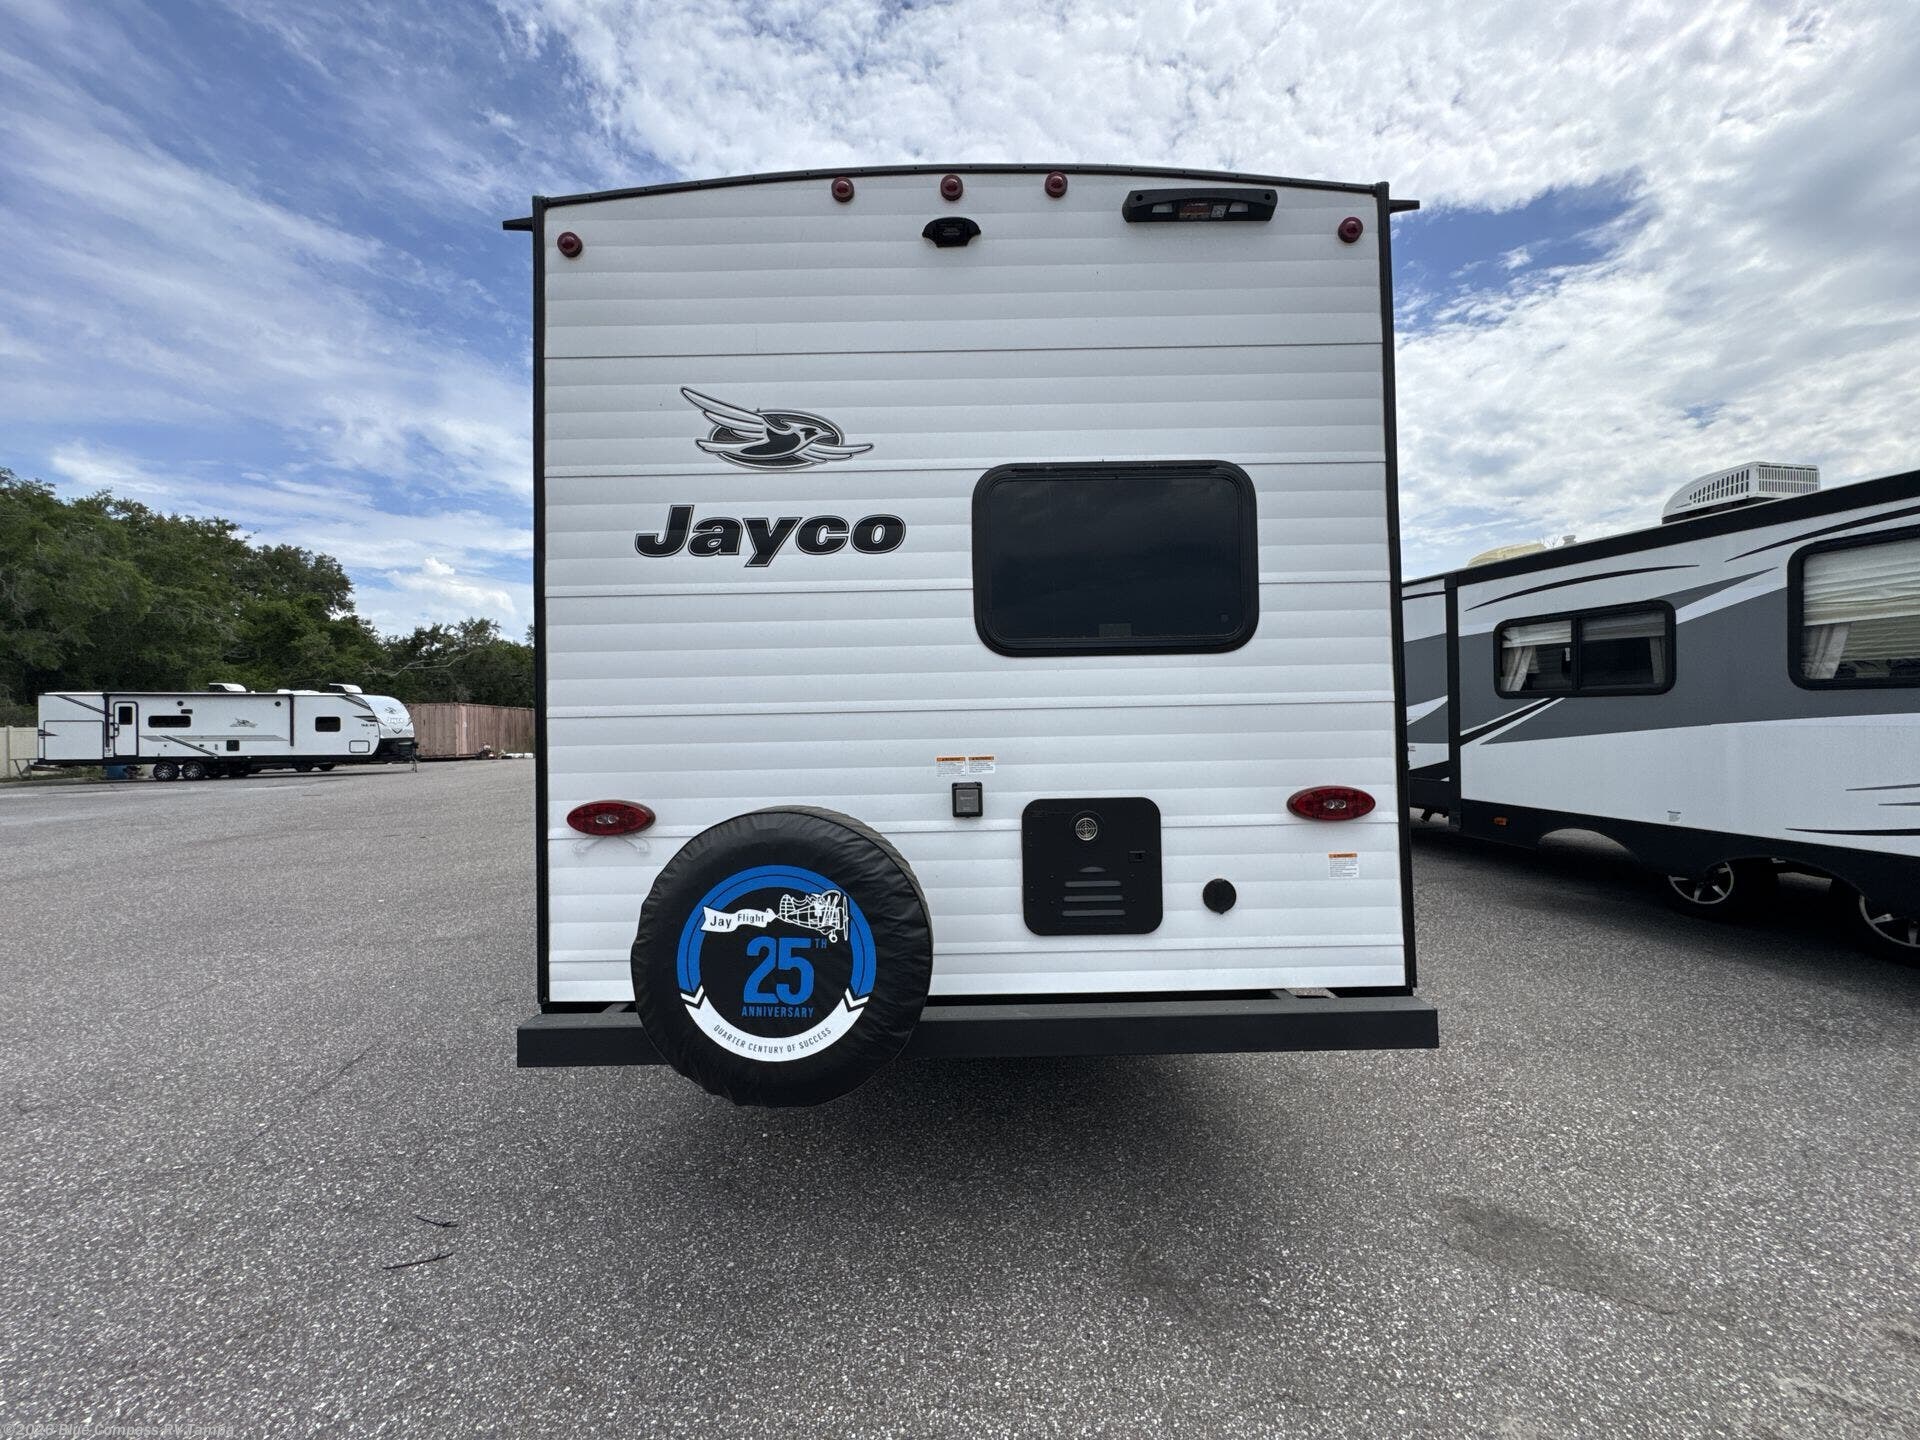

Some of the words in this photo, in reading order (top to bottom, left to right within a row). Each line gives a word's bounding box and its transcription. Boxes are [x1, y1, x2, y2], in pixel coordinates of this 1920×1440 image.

[634, 504, 907, 568] Jayco
[710, 915, 732, 929] Jay
[737, 913, 765, 924] Flight
[743, 936, 815, 1006] 25
[741, 1006, 814, 1018] ANNIVERSARY
[713, 1024, 746, 1047] QUARTER
[748, 1043, 784, 1054] CENTURY
[786, 1043, 797, 1053] OF
[799, 1027, 832, 1050] SUCCESS
